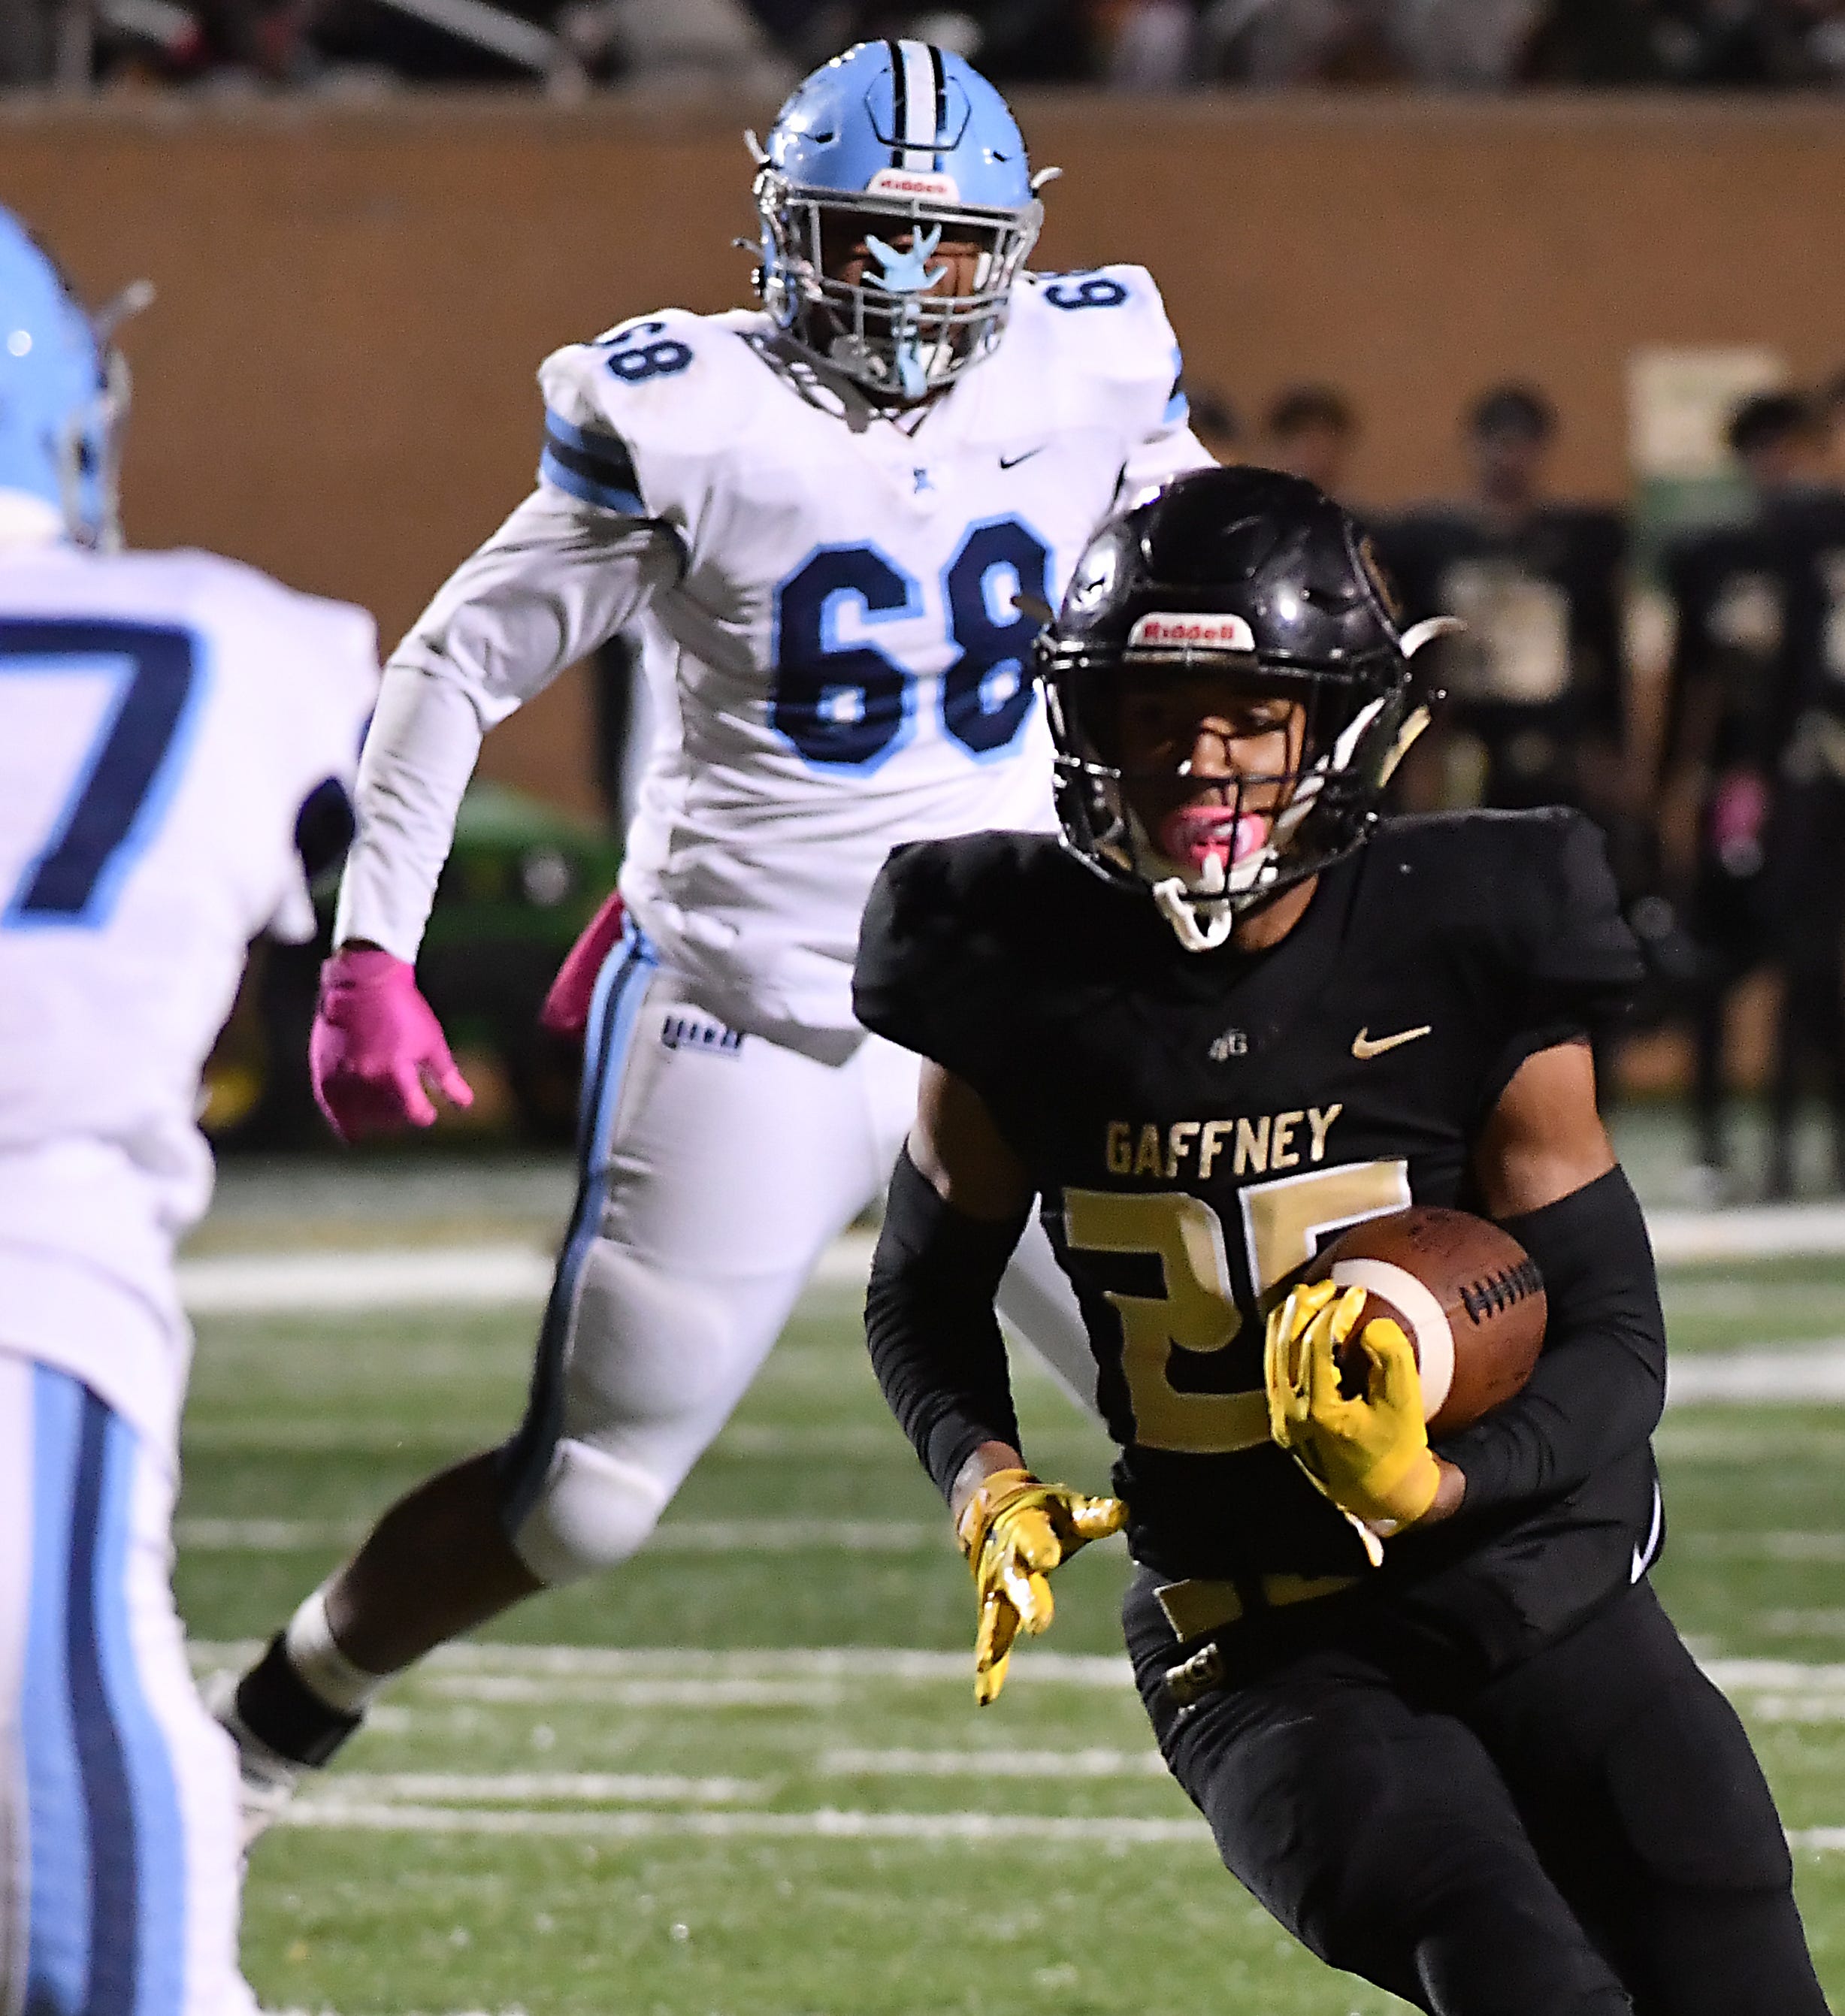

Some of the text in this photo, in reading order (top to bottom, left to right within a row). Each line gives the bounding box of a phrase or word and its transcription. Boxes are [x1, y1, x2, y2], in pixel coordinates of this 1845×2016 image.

[1043, 271, 1129, 311] 6
[767, 512, 1057, 778] 68
[0, 616, 209, 930] 7
[1106, 1103, 1344, 1180] GAFFNEY
